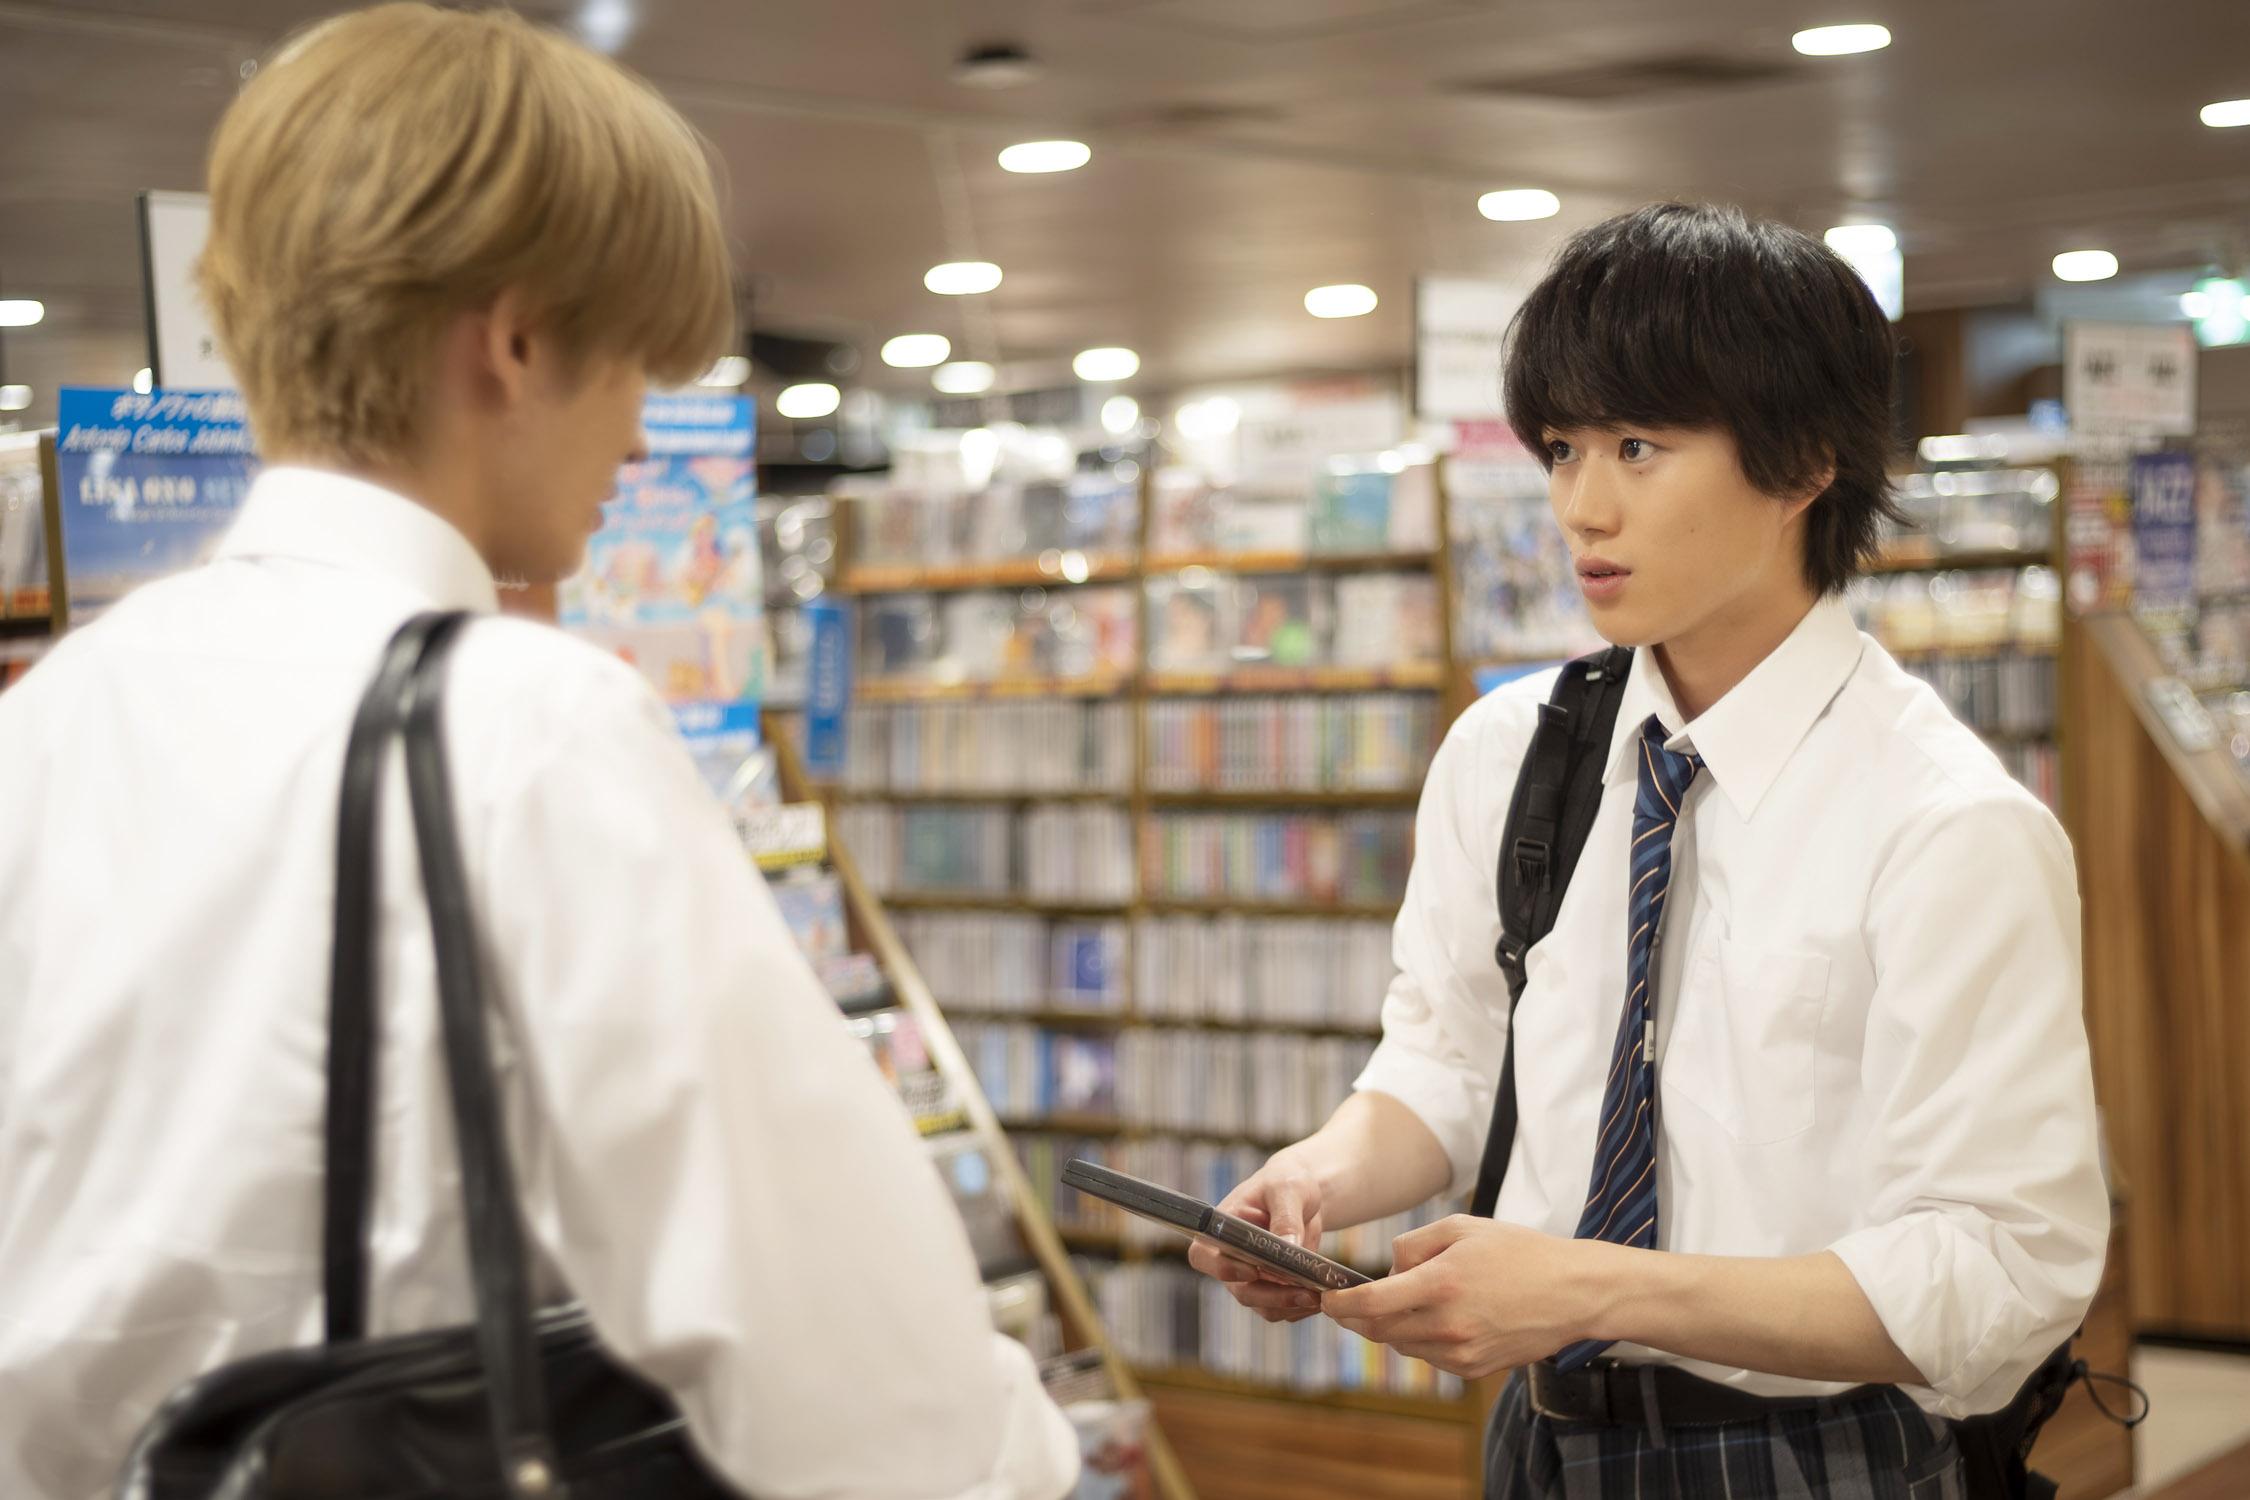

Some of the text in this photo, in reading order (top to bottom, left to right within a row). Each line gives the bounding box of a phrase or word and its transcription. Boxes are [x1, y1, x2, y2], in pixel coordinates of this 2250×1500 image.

[133, 424, 190, 453] Carlos
[1246, 1231, 1326, 1275] NOIR HAWK
